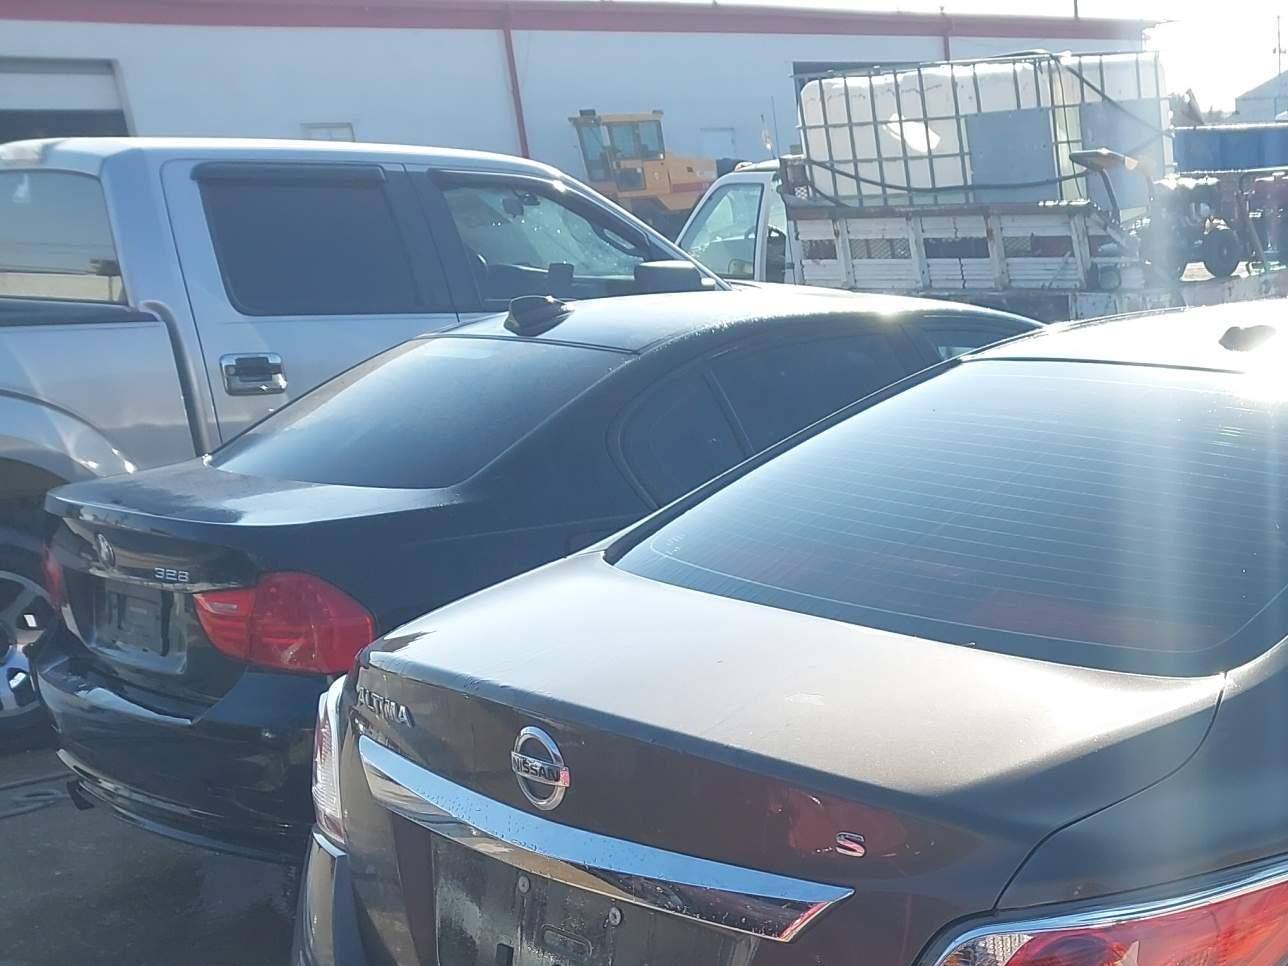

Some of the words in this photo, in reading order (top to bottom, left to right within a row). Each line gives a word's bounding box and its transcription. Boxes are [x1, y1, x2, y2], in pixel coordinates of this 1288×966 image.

[154, 567, 190, 582] 328
[356, 686, 412, 729] ALTIMA
[511, 756, 561, 782] NISSAN
[835, 831, 866, 857] S
